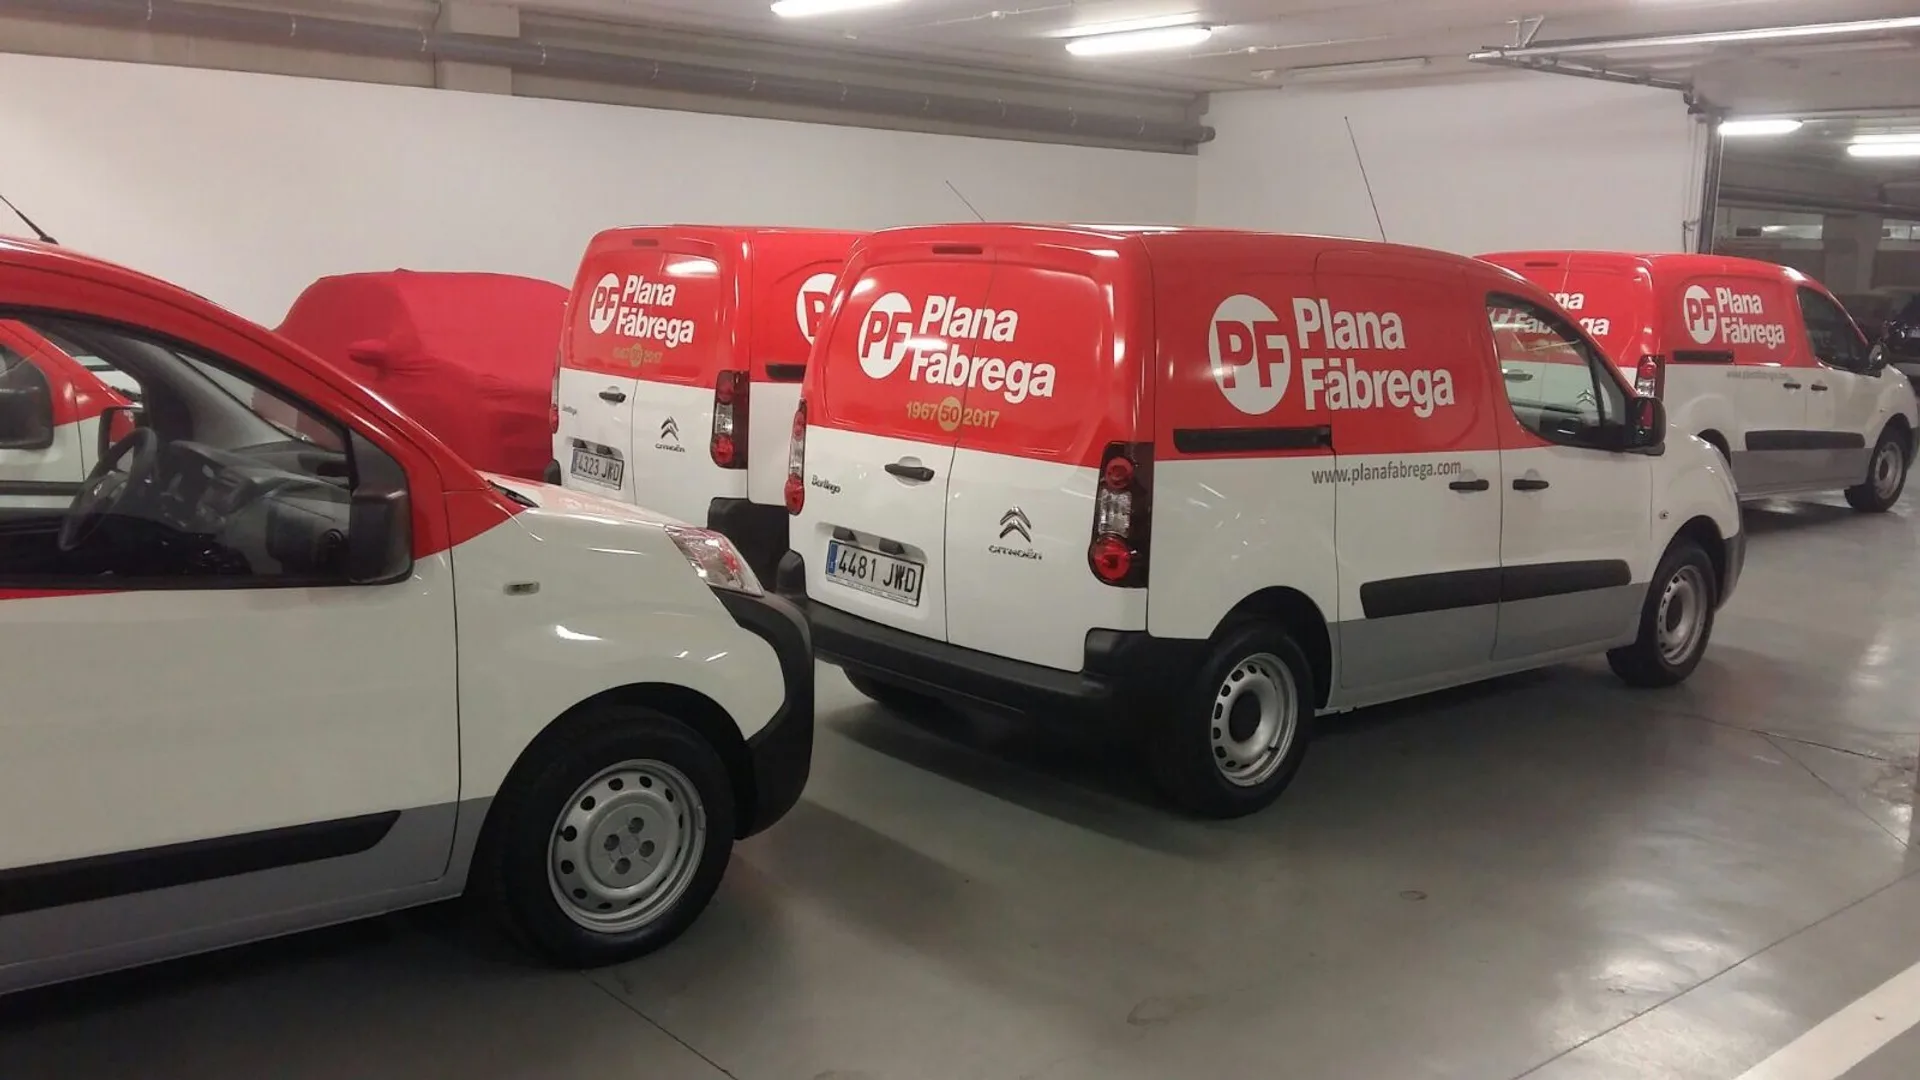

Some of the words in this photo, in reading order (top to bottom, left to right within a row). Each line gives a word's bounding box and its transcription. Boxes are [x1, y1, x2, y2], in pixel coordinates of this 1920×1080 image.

[622, 274, 677, 307] Plana
[1715, 287, 1763, 315] Plana
[861, 311, 911, 361] PF
[919, 295, 1018, 343] Plana
[1292, 297, 1406, 350] Plana
[1215, 320, 1285, 389] PF
[905, 401, 938, 421] 1967
[940, 405, 959, 423] 50
[962, 407, 1000, 429] 2017
[1311, 460, 1462, 486] www.planafabrega.com
[838, 549, 877, 582] 4481
[883, 563, 916, 593] JWD
